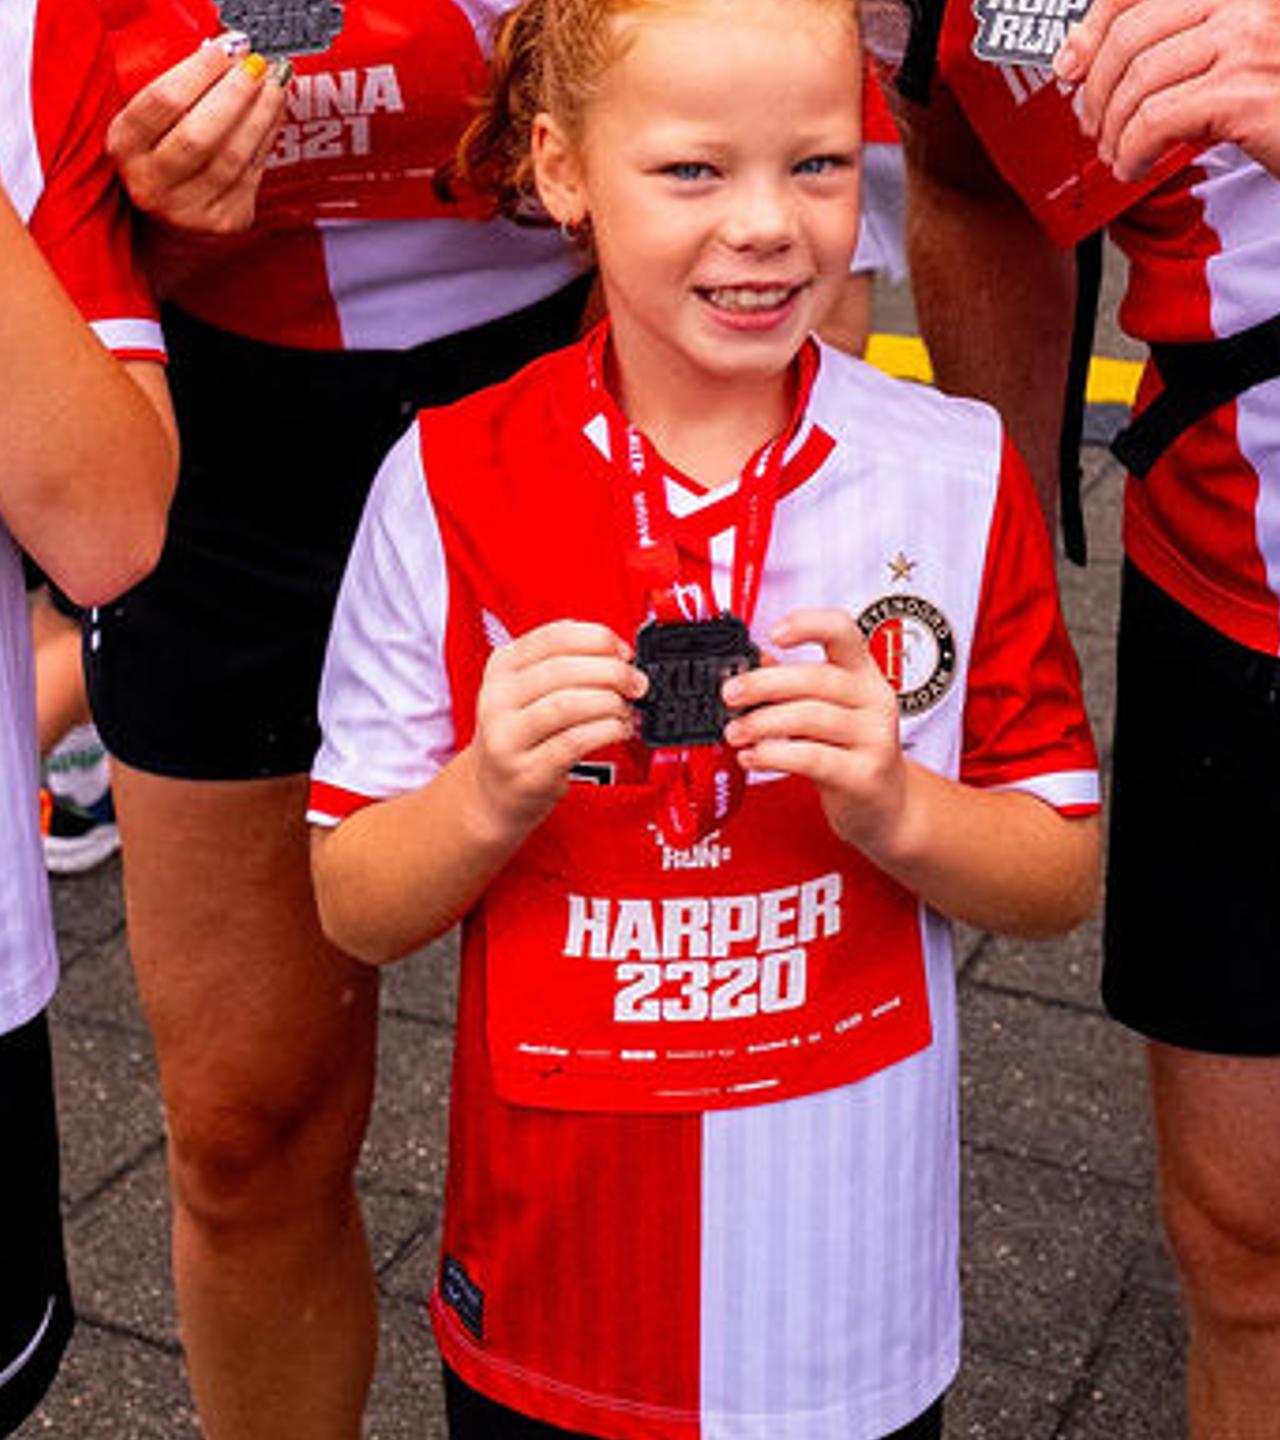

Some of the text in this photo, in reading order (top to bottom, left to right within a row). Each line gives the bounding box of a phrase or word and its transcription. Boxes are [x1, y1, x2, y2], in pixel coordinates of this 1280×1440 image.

[285, 63, 405, 122] NNA
[265, 116, 369, 169] 321
[562, 872, 843, 961] HARPER
[613, 945, 806, 1022] 2320
